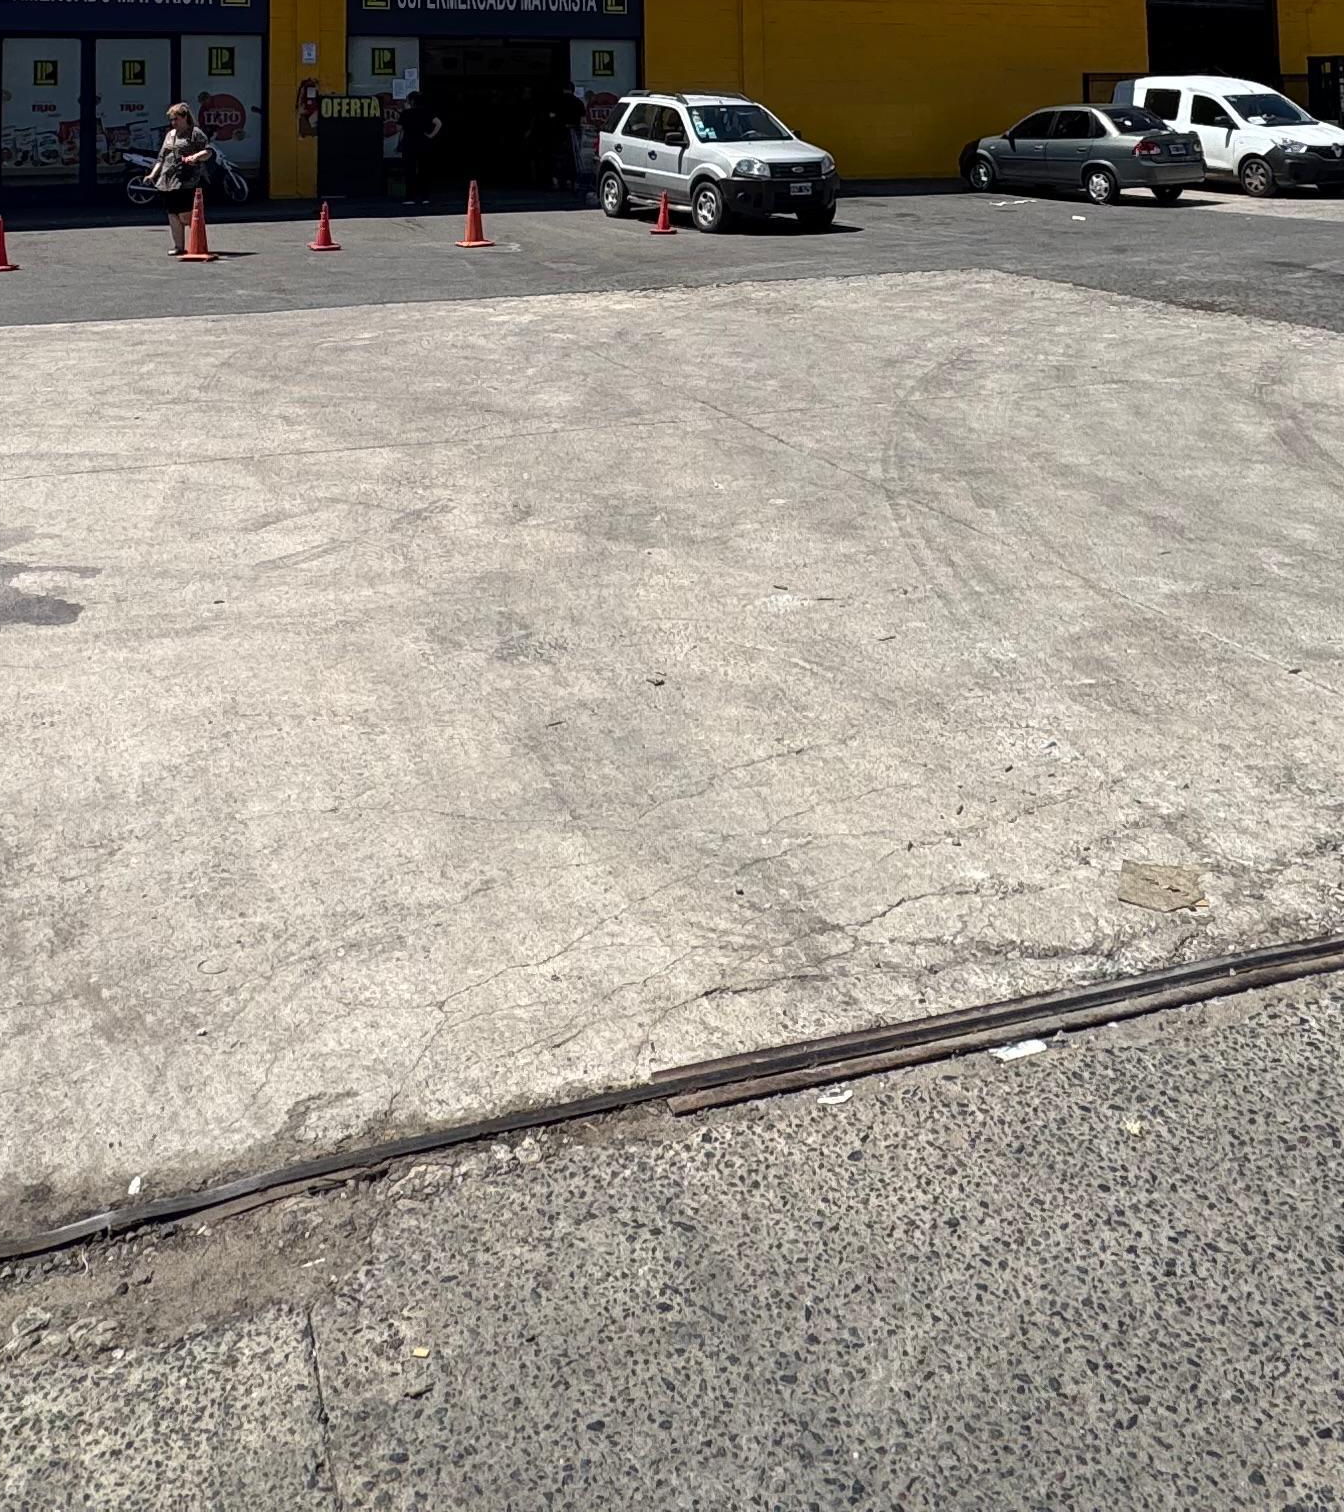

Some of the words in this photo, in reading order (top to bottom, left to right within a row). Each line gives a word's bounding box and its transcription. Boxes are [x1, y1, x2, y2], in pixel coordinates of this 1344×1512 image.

[120, 104, 144, 113] TRIO
[321, 96, 381, 119] OFERTA
[205, 110, 241, 127] TRIO
